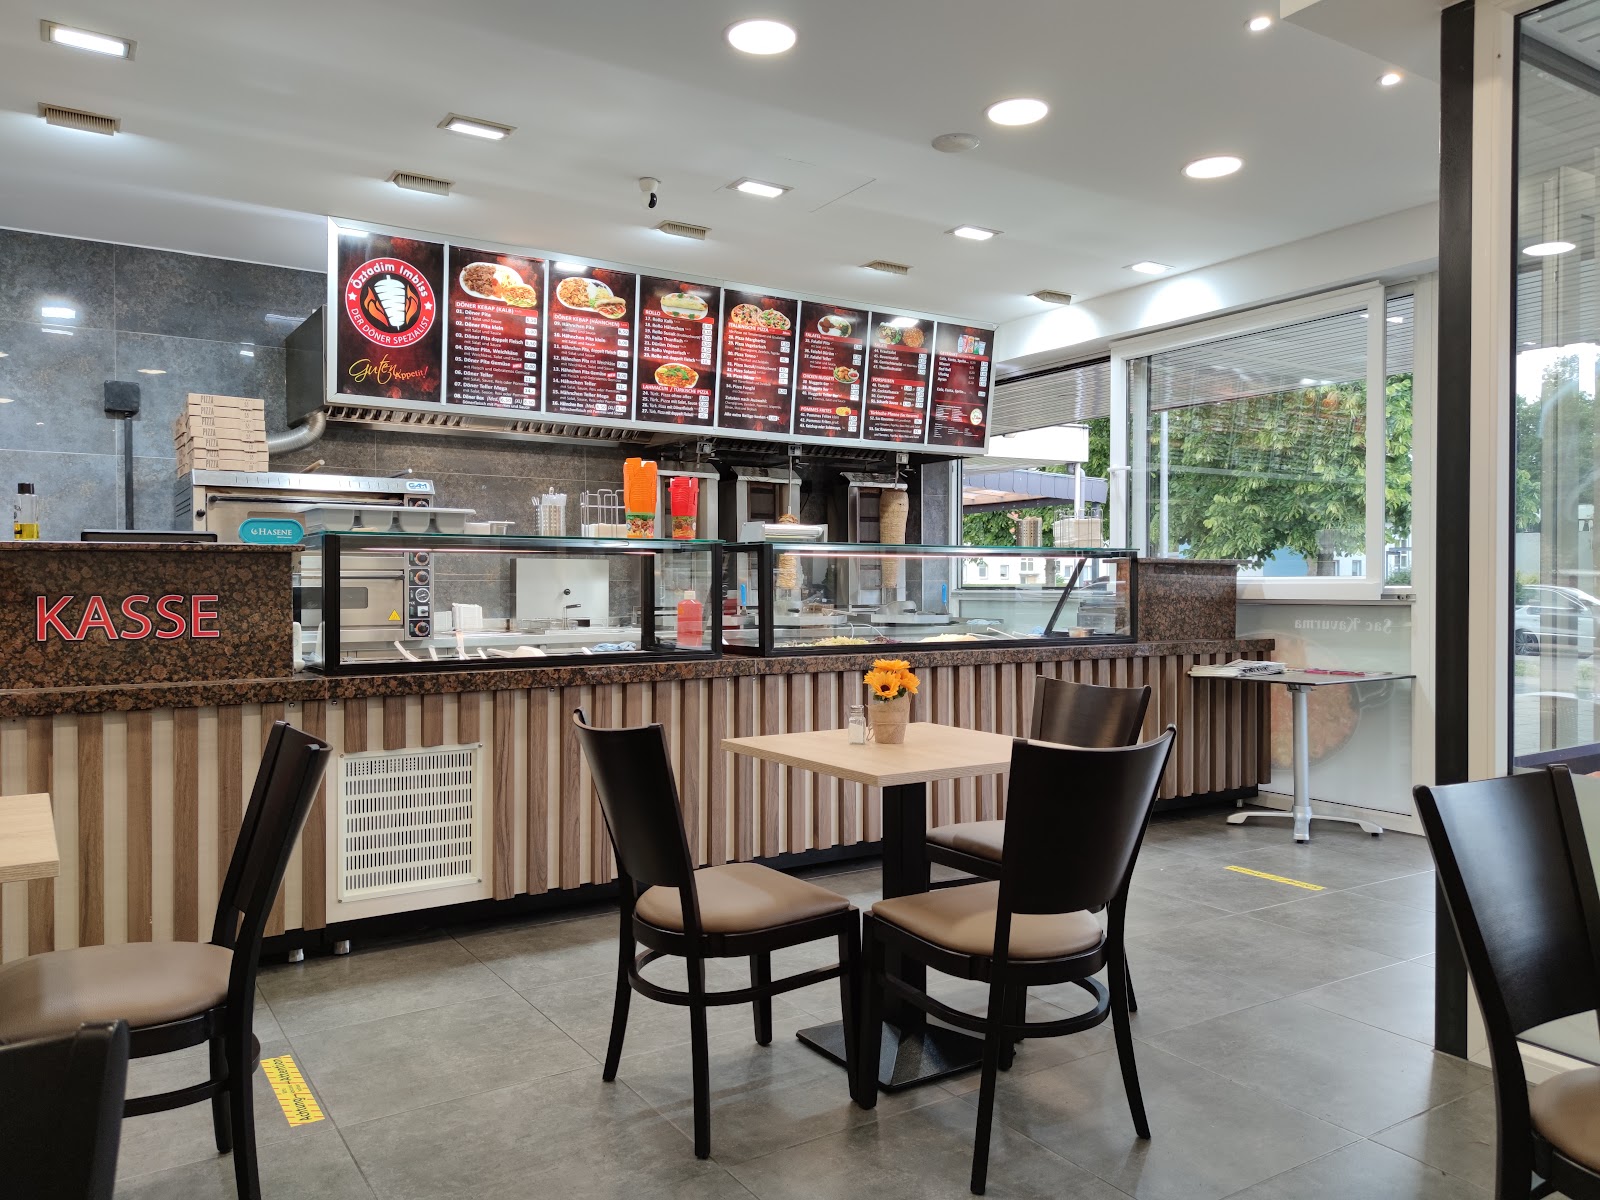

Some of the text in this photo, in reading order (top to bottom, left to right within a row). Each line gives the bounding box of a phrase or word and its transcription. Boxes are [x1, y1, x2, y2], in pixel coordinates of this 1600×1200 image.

[351, 262, 428, 298] Öztadim Imbiss
[496, 306, 514, 314] (KALB)
[352, 308, 430, 344] DER DÖNER SPEZIALIST
[590, 318, 620, 327] (HÄHNCHEN)
[348, 354, 428, 384] Guten Appetit!
[201, 407, 214, 415] PIZZA
[202, 418, 215, 426] PIZZA
[203, 428, 216, 436] PIZZA
[206, 460, 219, 468] PIZZA
[37, 595, 219, 641] KASSE
[273, 1059, 292, 1082] Attention
[293, 1097, 312, 1121] Achtung
